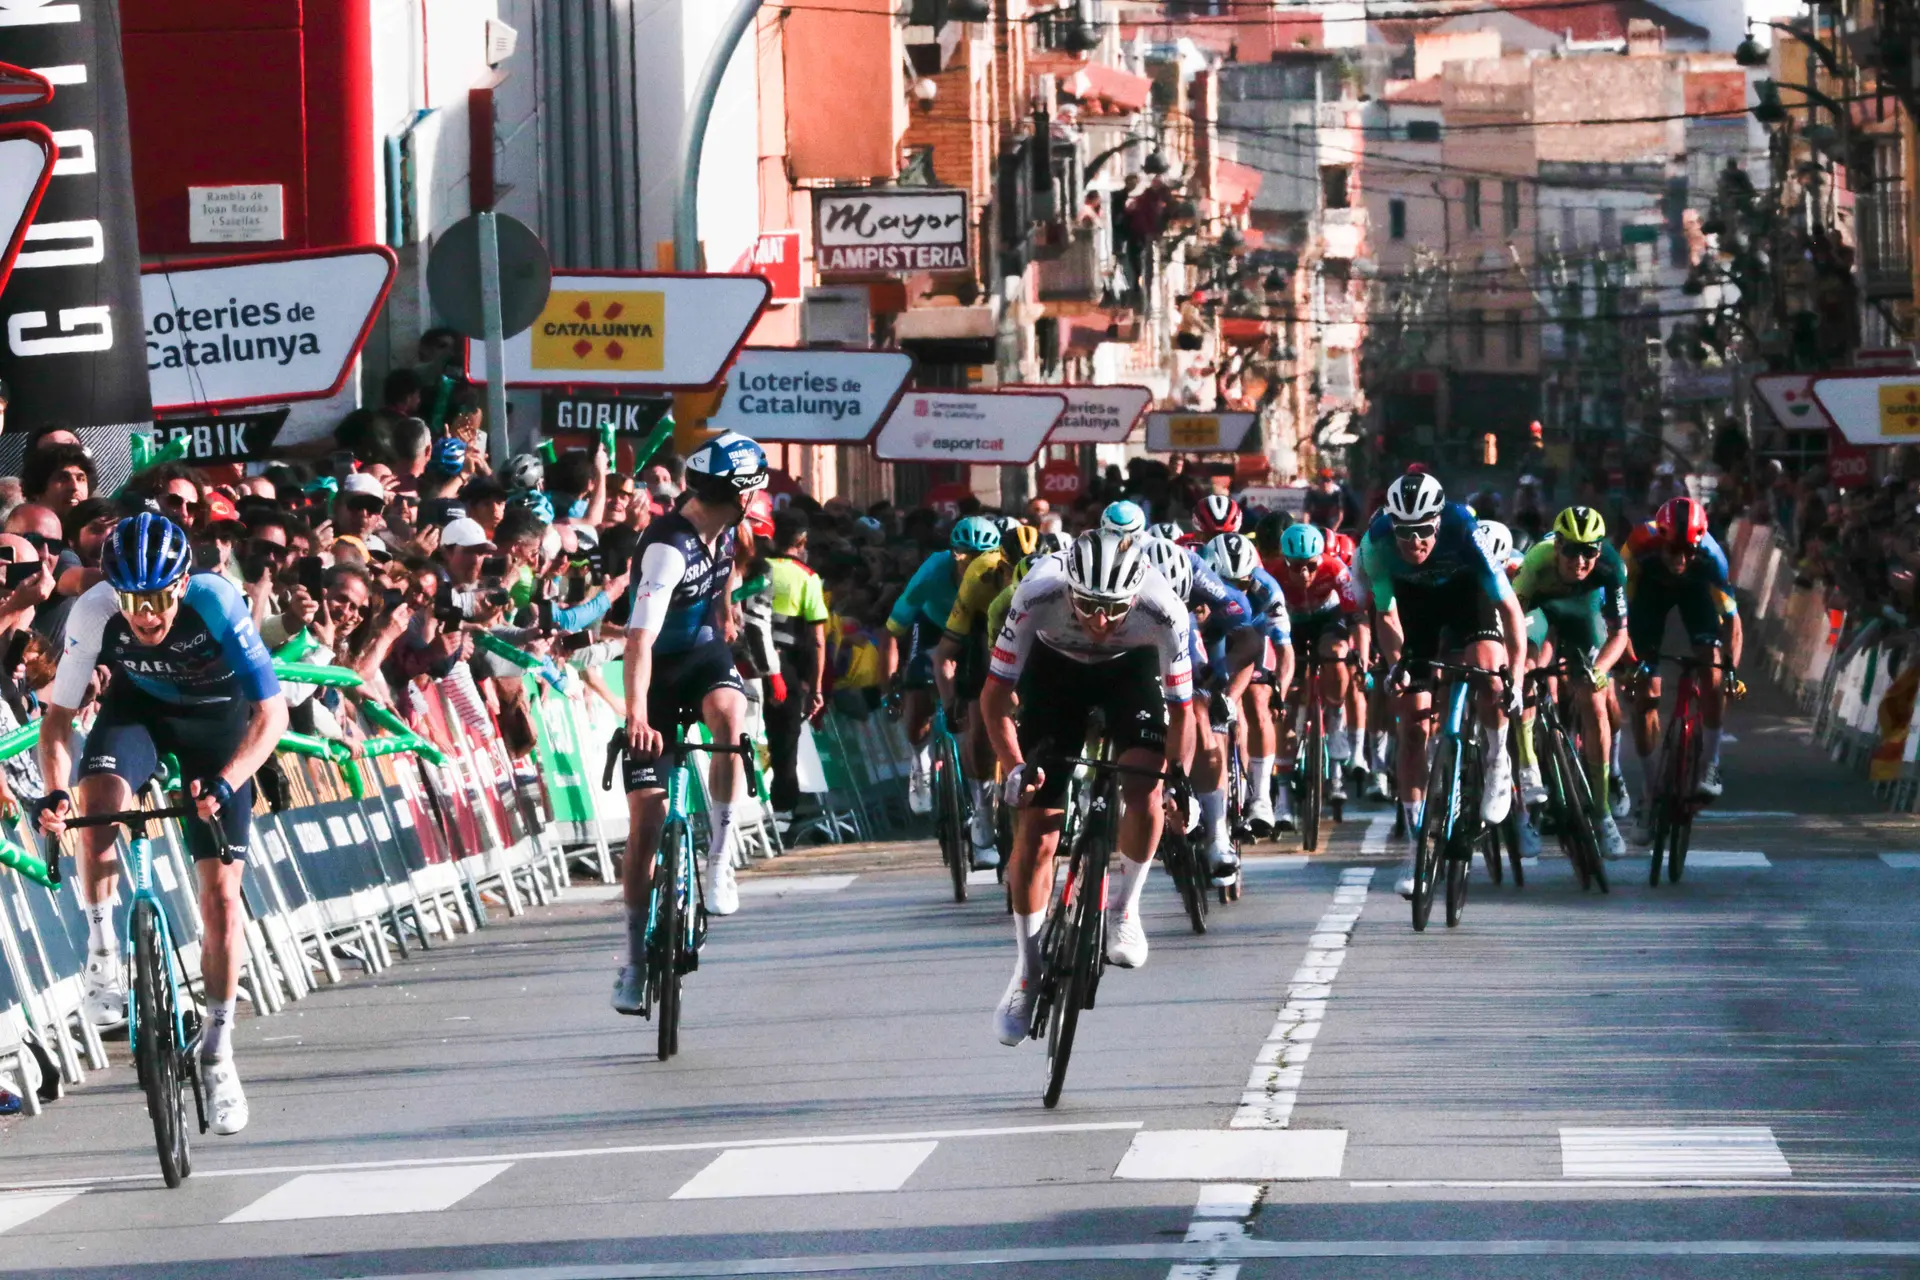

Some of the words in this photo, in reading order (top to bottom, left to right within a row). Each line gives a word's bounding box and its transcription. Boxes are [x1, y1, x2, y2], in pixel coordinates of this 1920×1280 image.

[206, 192, 246, 201] Rambla
[250, 191, 264, 200] de
[824, 203, 962, 239] Mayor
[817, 245, 966, 270] LAMPISTERIA
[145, 298, 282, 335] oteries
[286, 302, 316, 322] de
[543, 321, 654, 338] CATALUNYA
[738, 371, 838, 393] Loteries
[841, 378, 862, 393] de
[557, 401, 640, 431] GOBIK
[738, 395, 862, 421] Catalunya
[1066, 401, 1105, 415] eries
[933, 438, 1004, 452] esportcat
[1832, 457, 1867, 476] 200
[1044, 474, 1079, 491] 200
